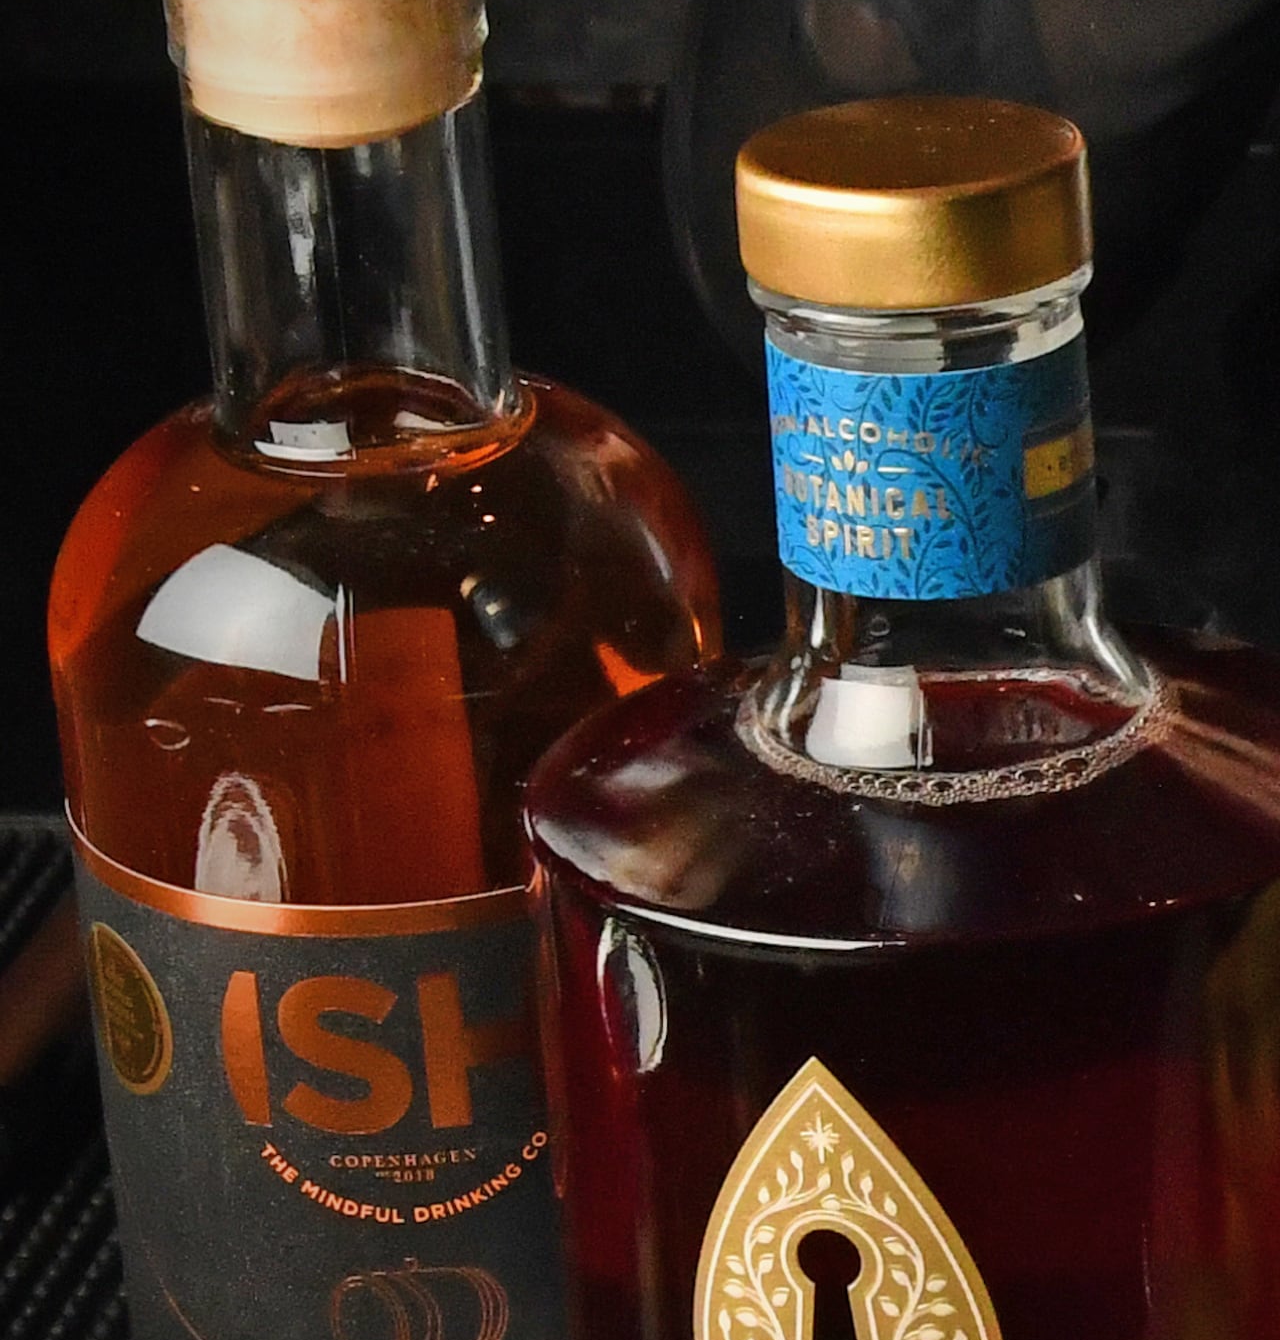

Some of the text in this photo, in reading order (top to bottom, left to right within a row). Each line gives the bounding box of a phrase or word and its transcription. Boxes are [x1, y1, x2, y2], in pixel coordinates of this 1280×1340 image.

[806, 514, 914, 559] SPIRIT
[261, 1131, 547, 1223] THE MINDFUL DRINKING CO
[329, 1148, 476, 1168] COPENHAGEN
